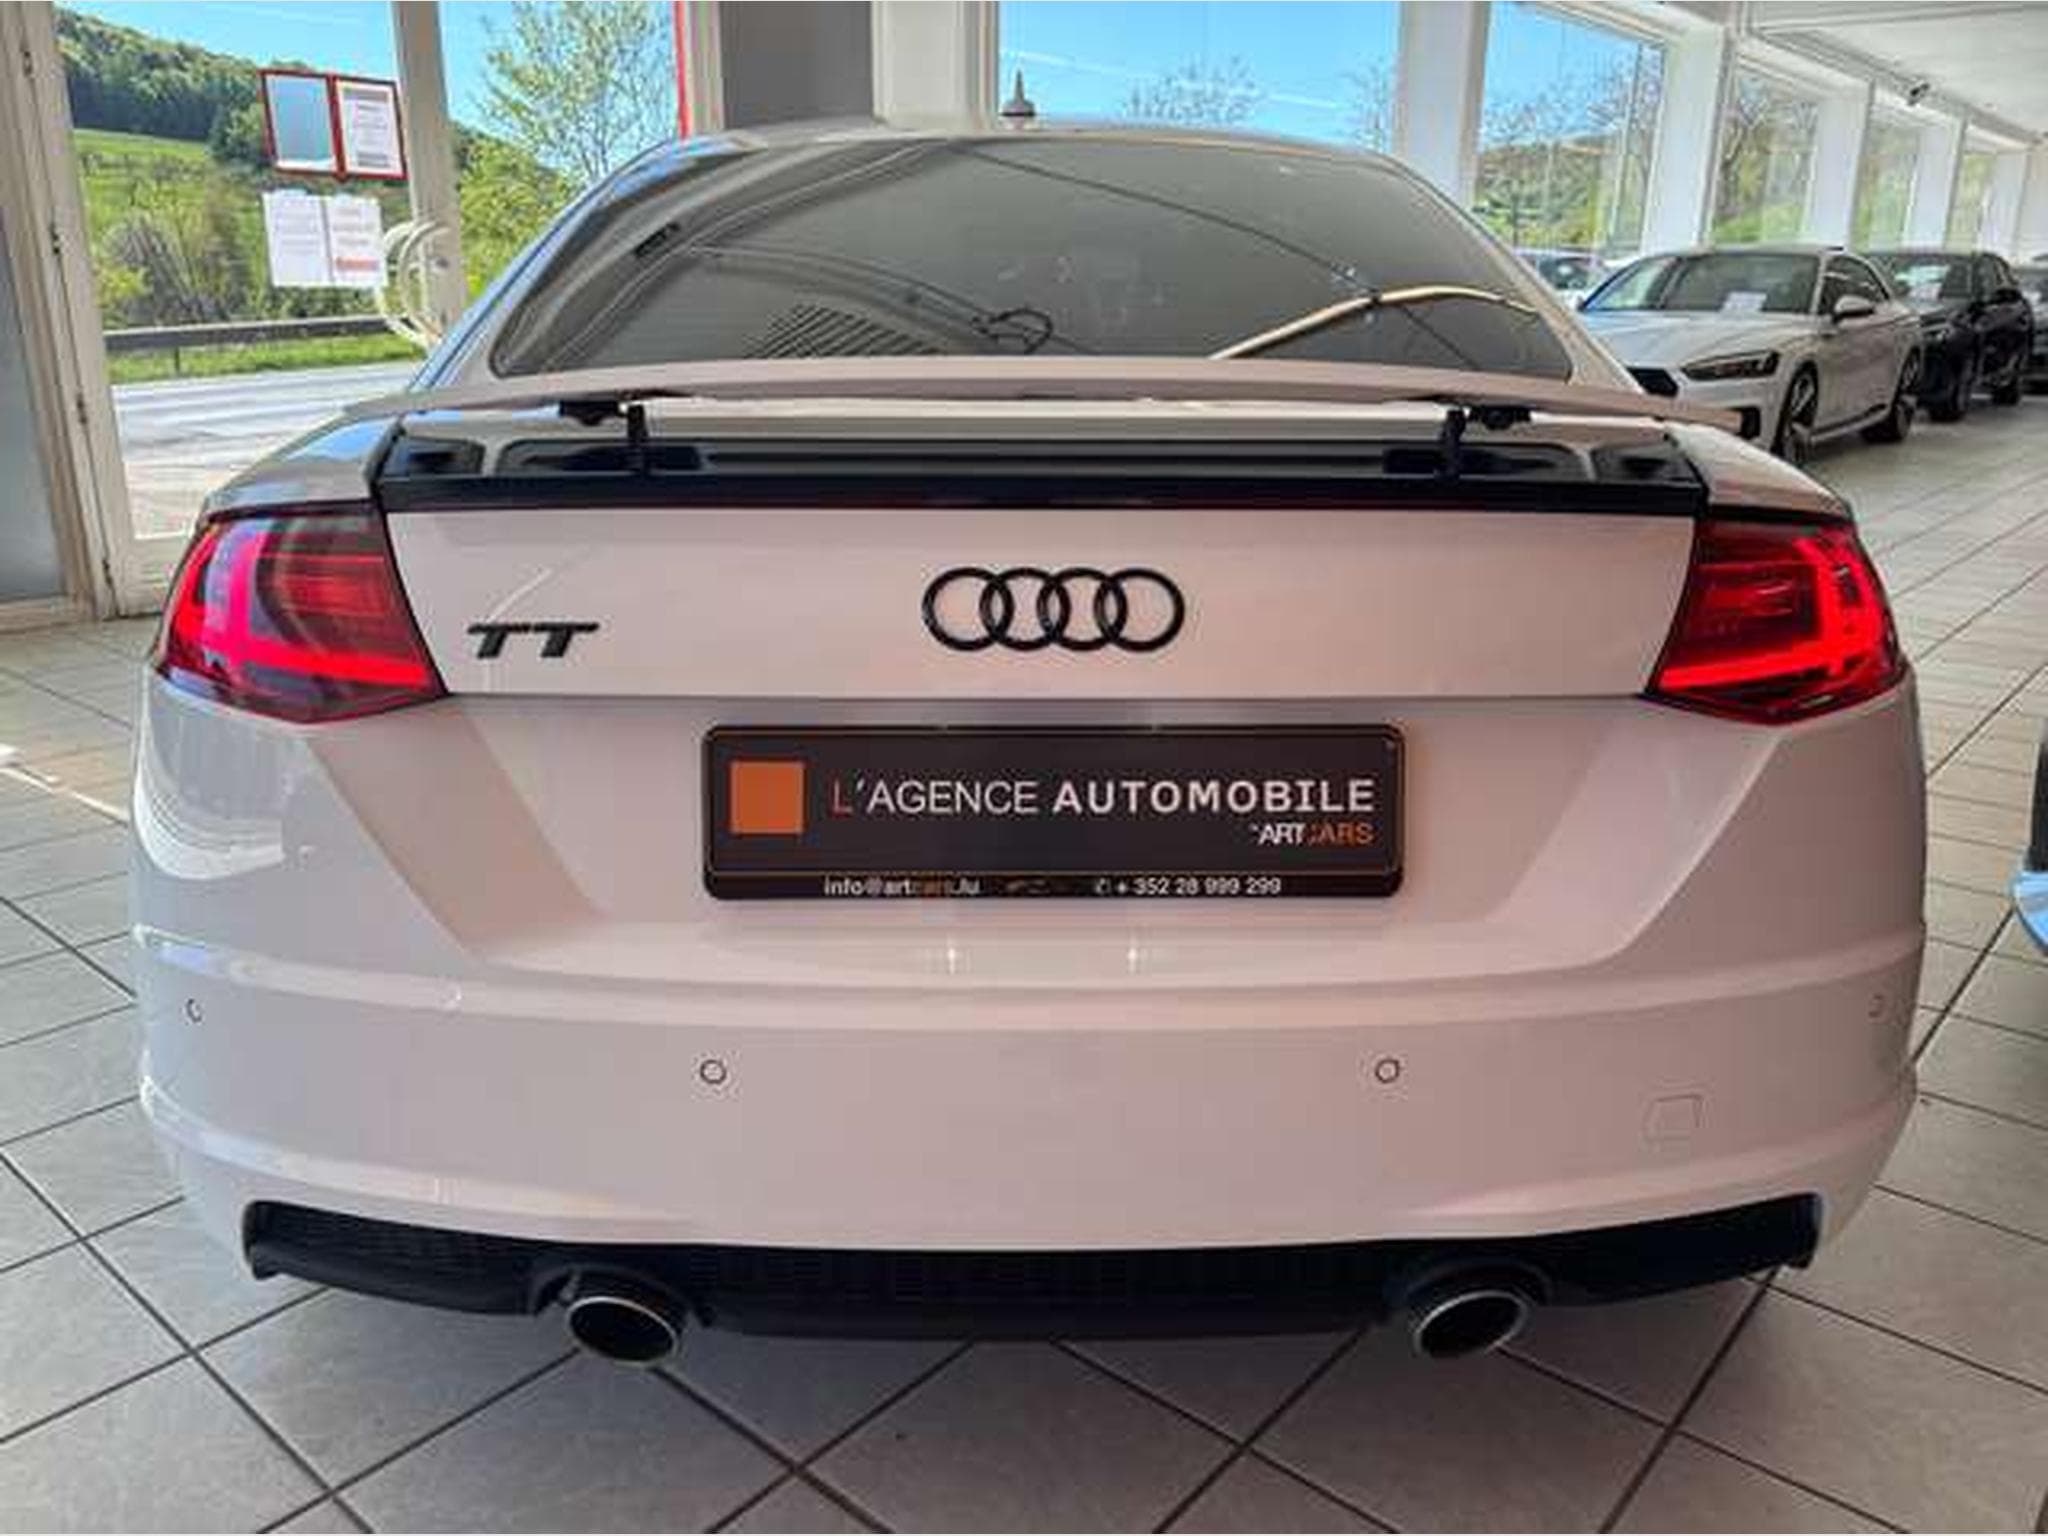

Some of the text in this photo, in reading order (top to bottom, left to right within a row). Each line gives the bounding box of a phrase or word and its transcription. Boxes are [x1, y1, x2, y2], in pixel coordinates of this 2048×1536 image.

[467, 622, 599, 659] TT
[832, 778, 1374, 814] L'AGENCE AUTOMOBILE
[1133, 877, 1169, 895] 352
[1246, 877, 1282, 895] 299
